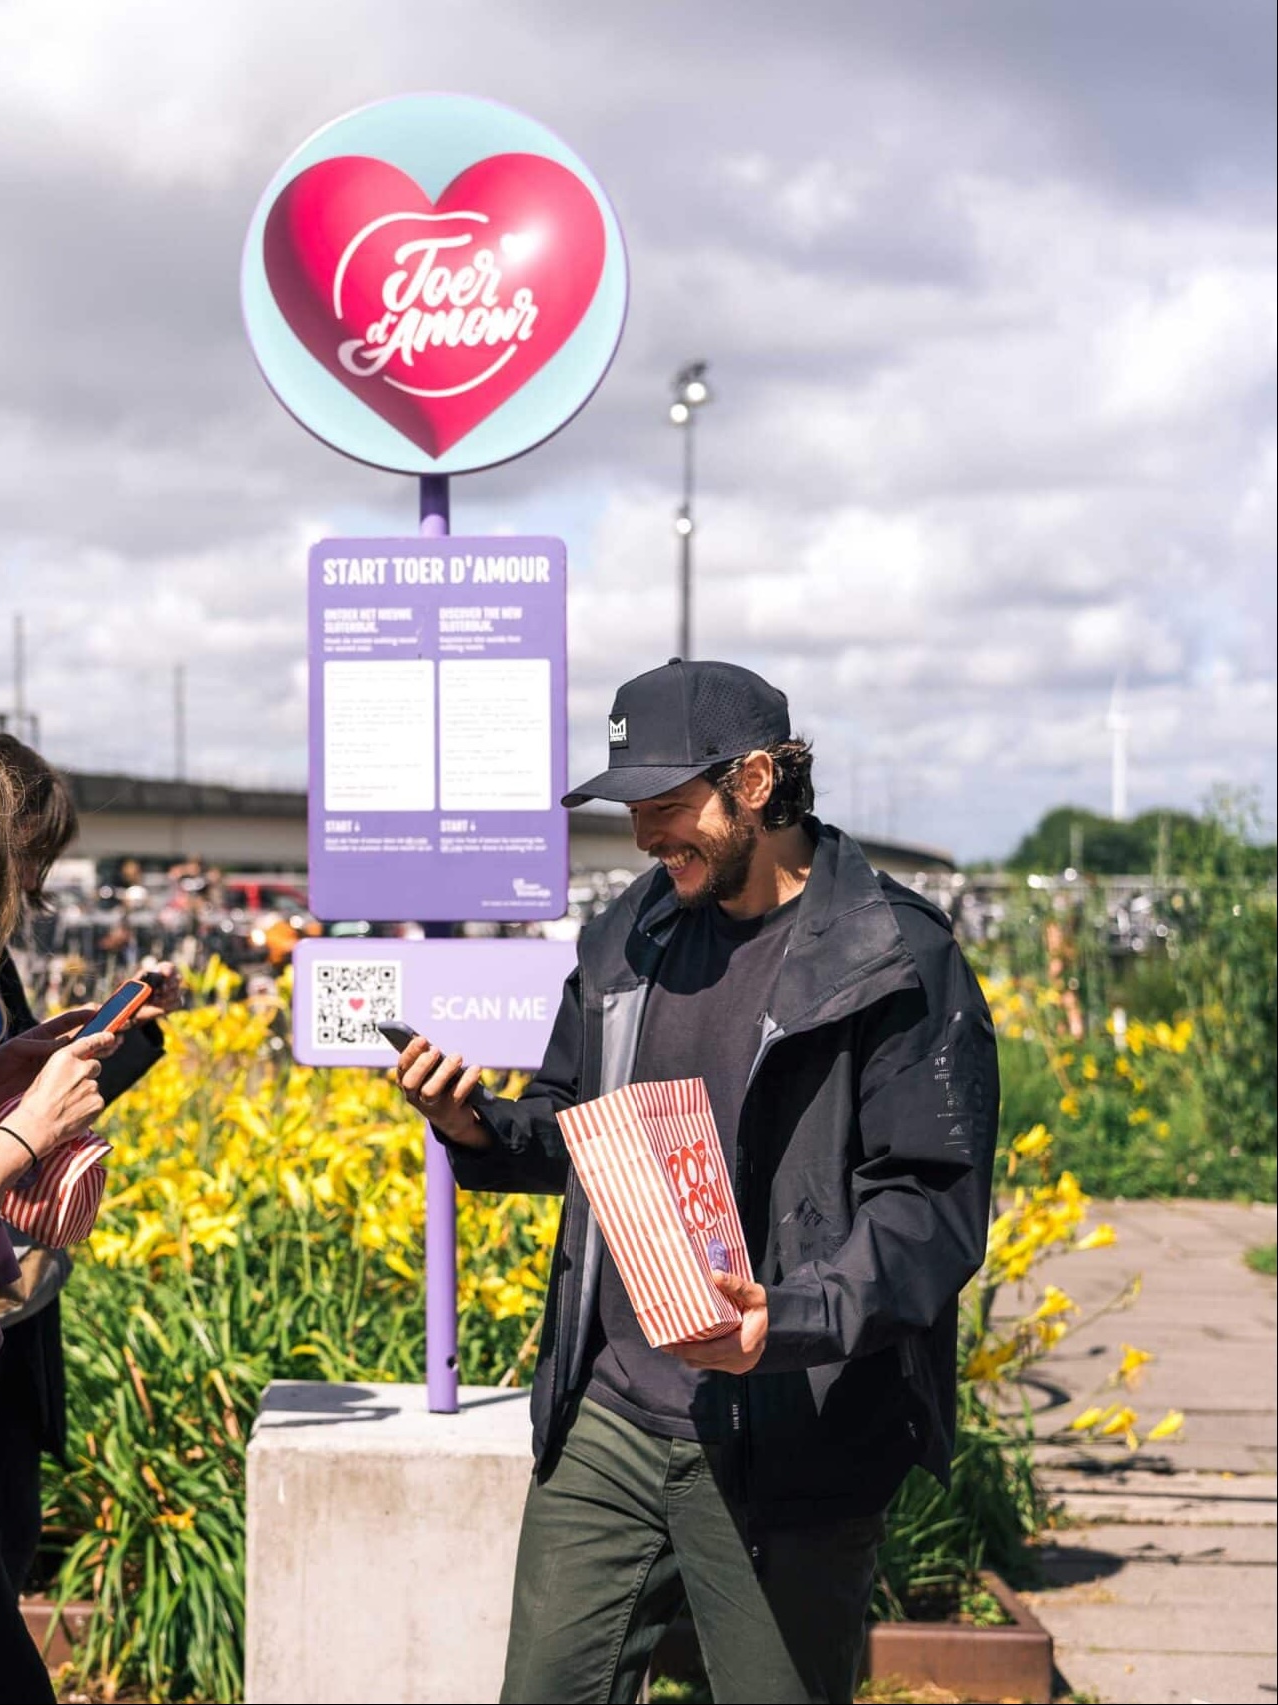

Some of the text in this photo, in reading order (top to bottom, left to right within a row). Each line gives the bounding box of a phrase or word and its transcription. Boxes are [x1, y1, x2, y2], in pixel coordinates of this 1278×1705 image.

[382, 233, 502, 312] Toer
[323, 554, 551, 585] START TOER D'AMOUR
[324, 819, 353, 833] START
[439, 818, 468, 833] START
[430, 995, 548, 1021] SCAN ME
[667, 1139, 709, 1196] POP
[679, 1180, 727, 1235] CORN
